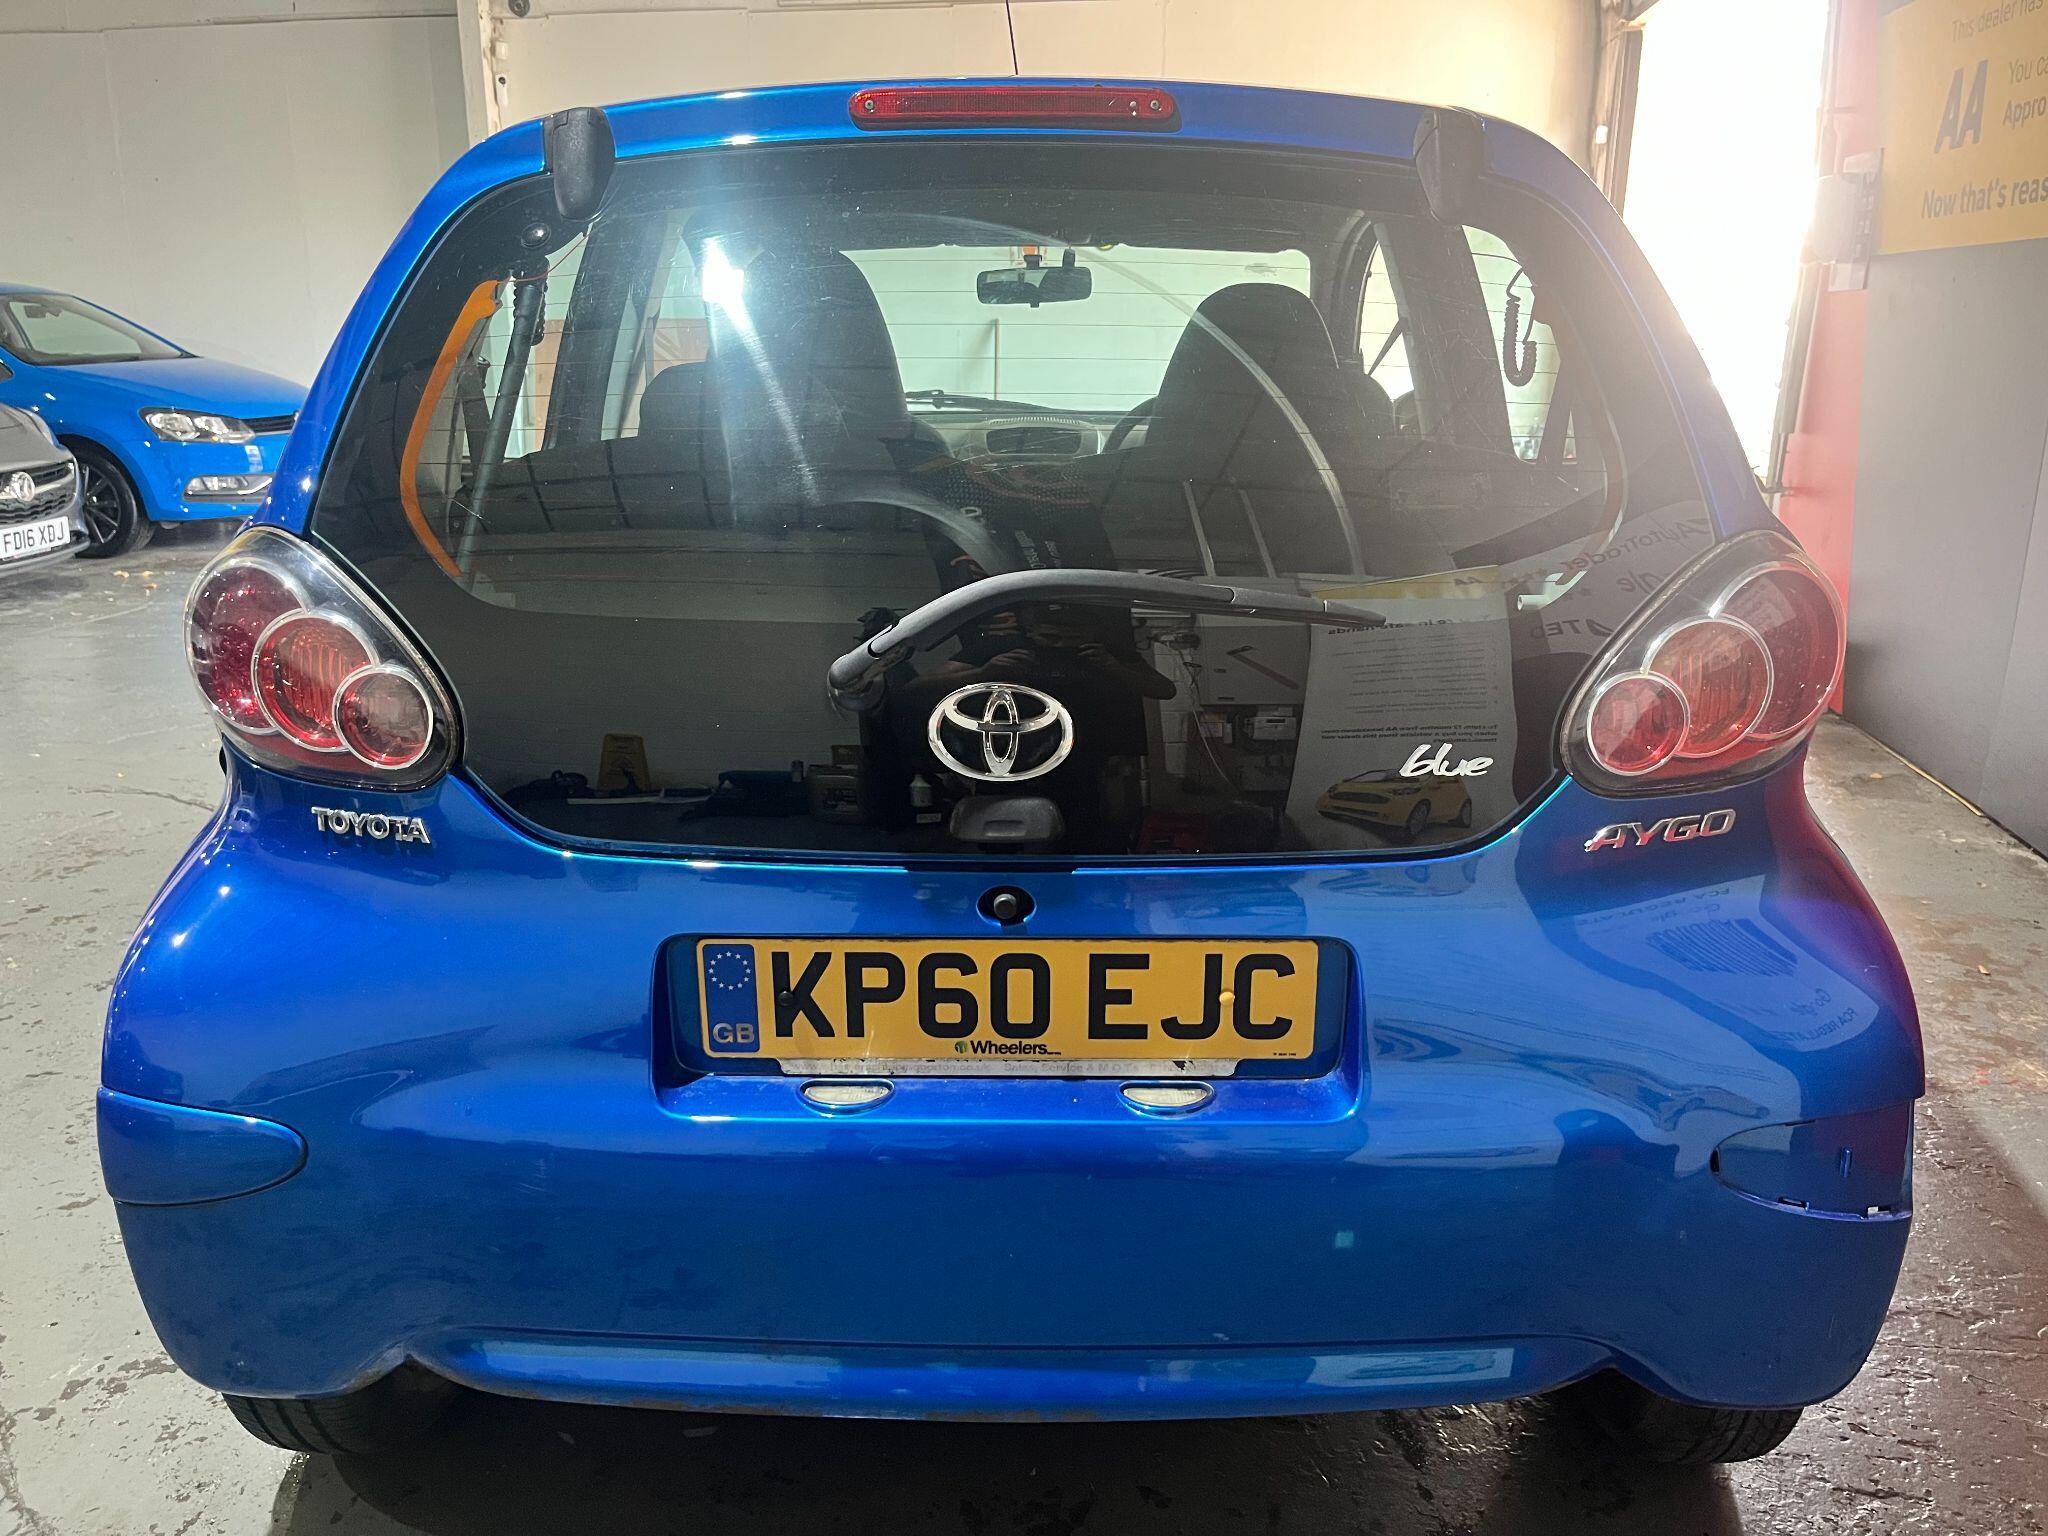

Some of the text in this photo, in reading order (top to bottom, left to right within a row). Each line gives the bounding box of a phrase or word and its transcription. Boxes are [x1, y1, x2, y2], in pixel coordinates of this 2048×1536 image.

[2008, 58, 2034, 84] You
[1933, 59, 1988, 153] AA
[1921, 190, 1957, 219] Now
[1960, 177, 2007, 213] that's
[3, 522, 65, 553] FD16 XDJ
[1399, 743, 1494, 777] blue
[311, 806, 431, 844] TOYOTA
[1584, 808, 1737, 852] AYGO
[772, 951, 1296, 1041] KP60 EJC
[712, 1023, 756, 1045] GB
[969, 1040, 1048, 1055] Wheelers
